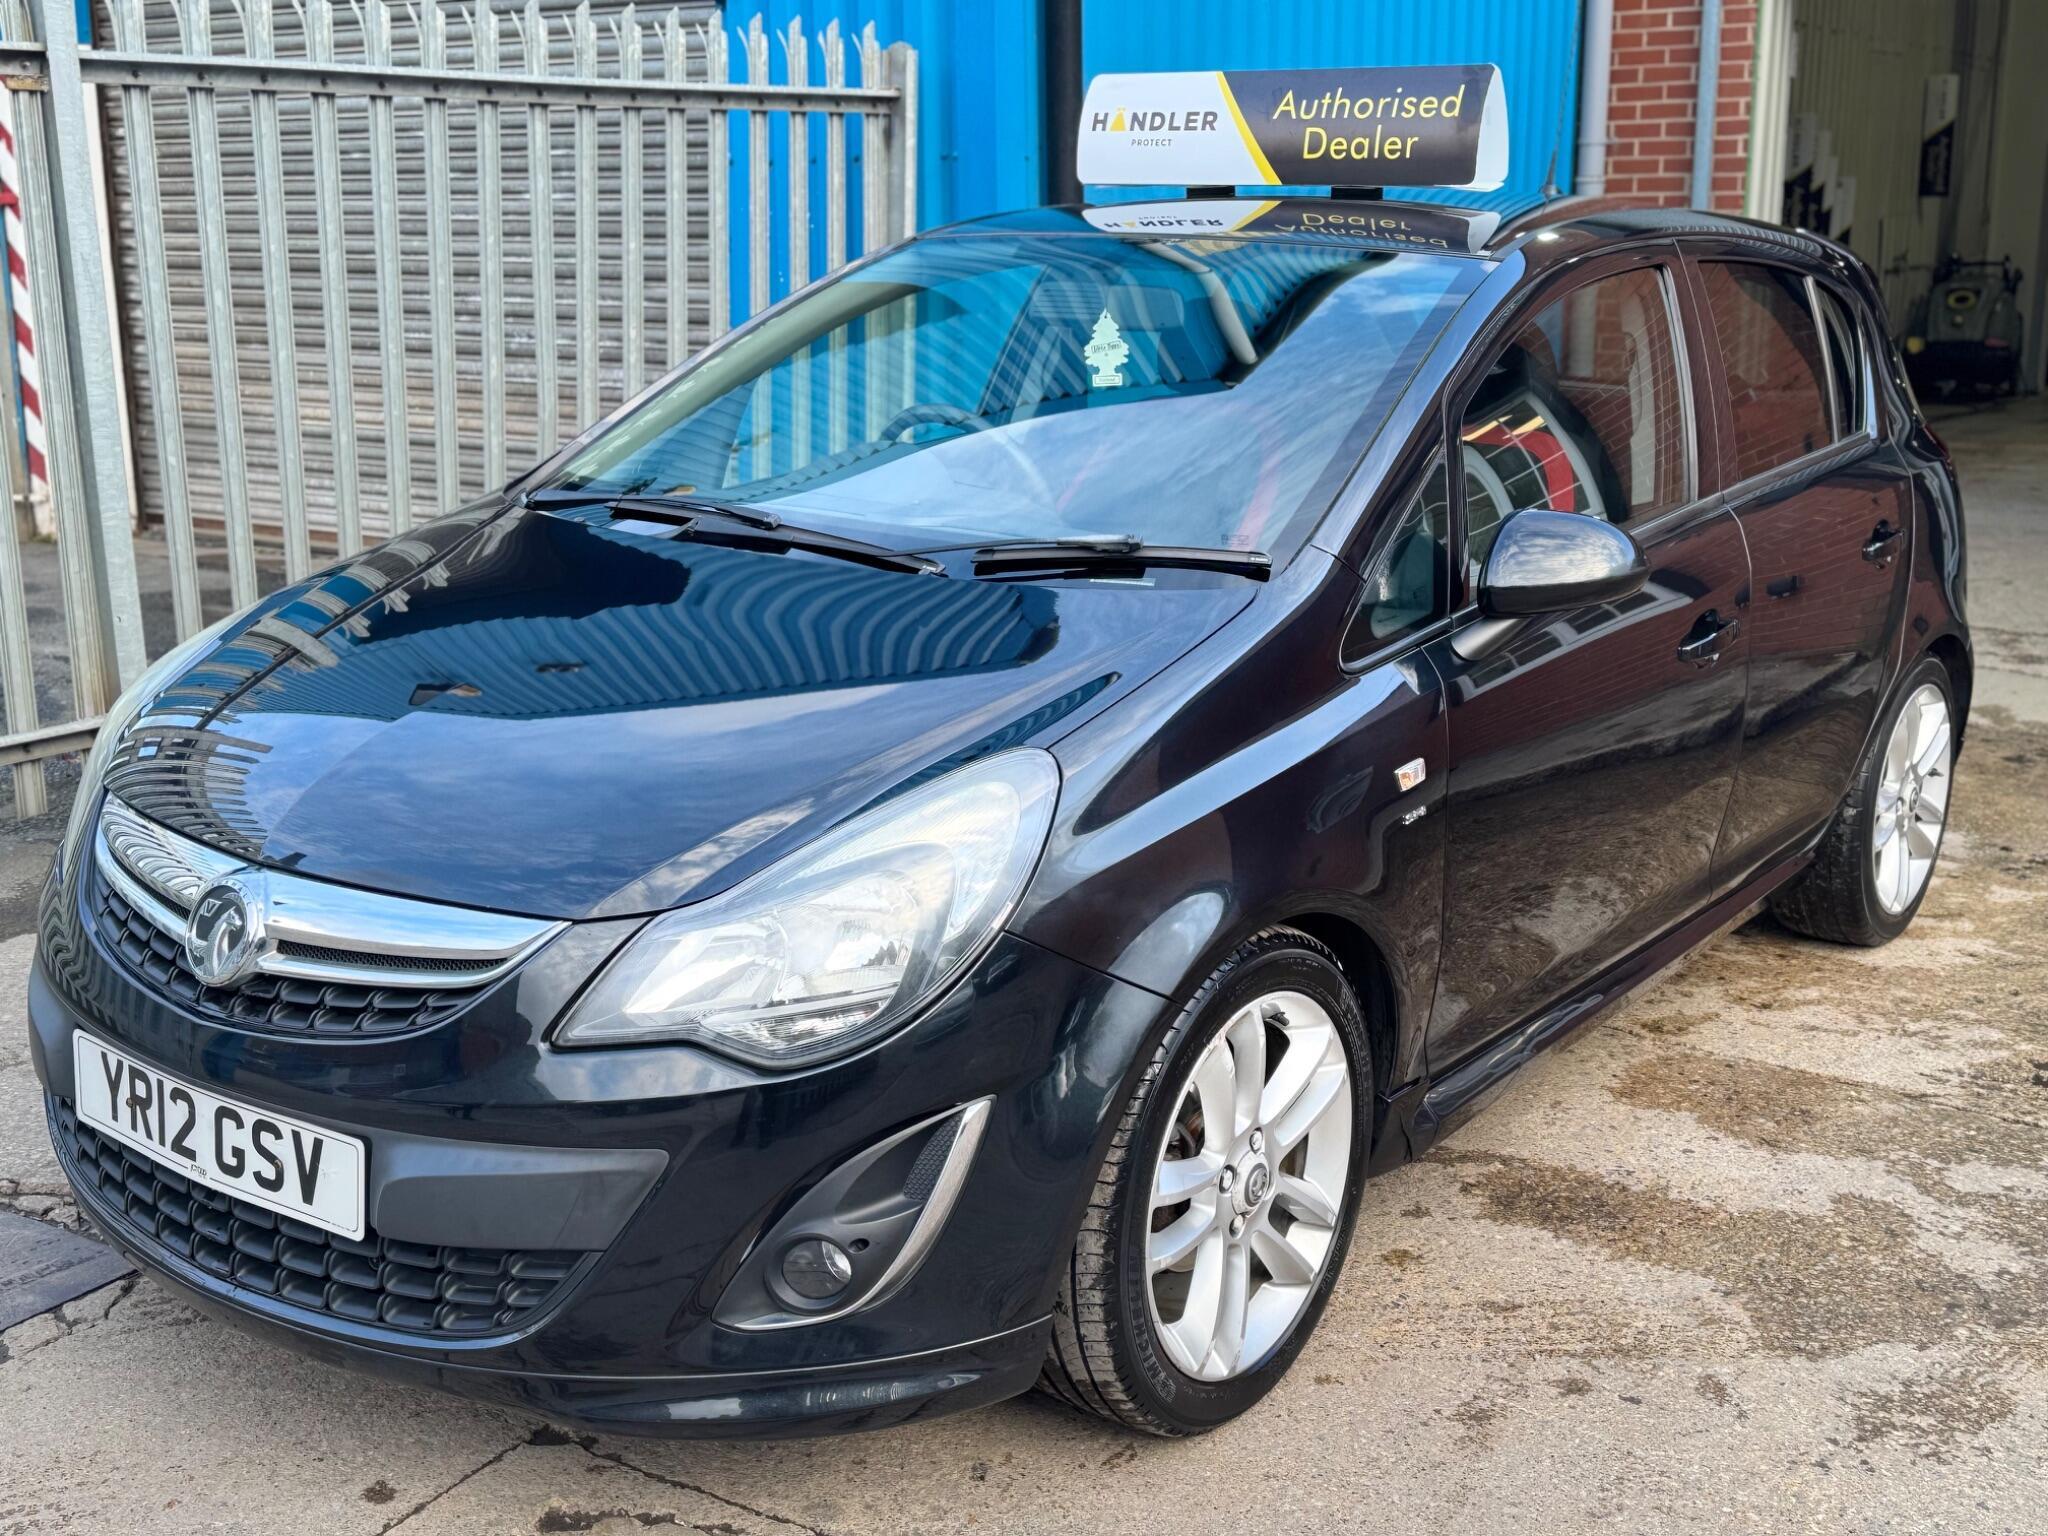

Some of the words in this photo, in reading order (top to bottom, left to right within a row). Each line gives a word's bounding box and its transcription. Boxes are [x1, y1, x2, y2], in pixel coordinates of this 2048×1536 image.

[1273, 84, 1465, 120] Authorised
[1131, 138, 1172, 147] PROTECT
[1302, 126, 1419, 161] Dealer
[100, 1050, 197, 1162] YR12
[214, 1105, 324, 1206] GSV
